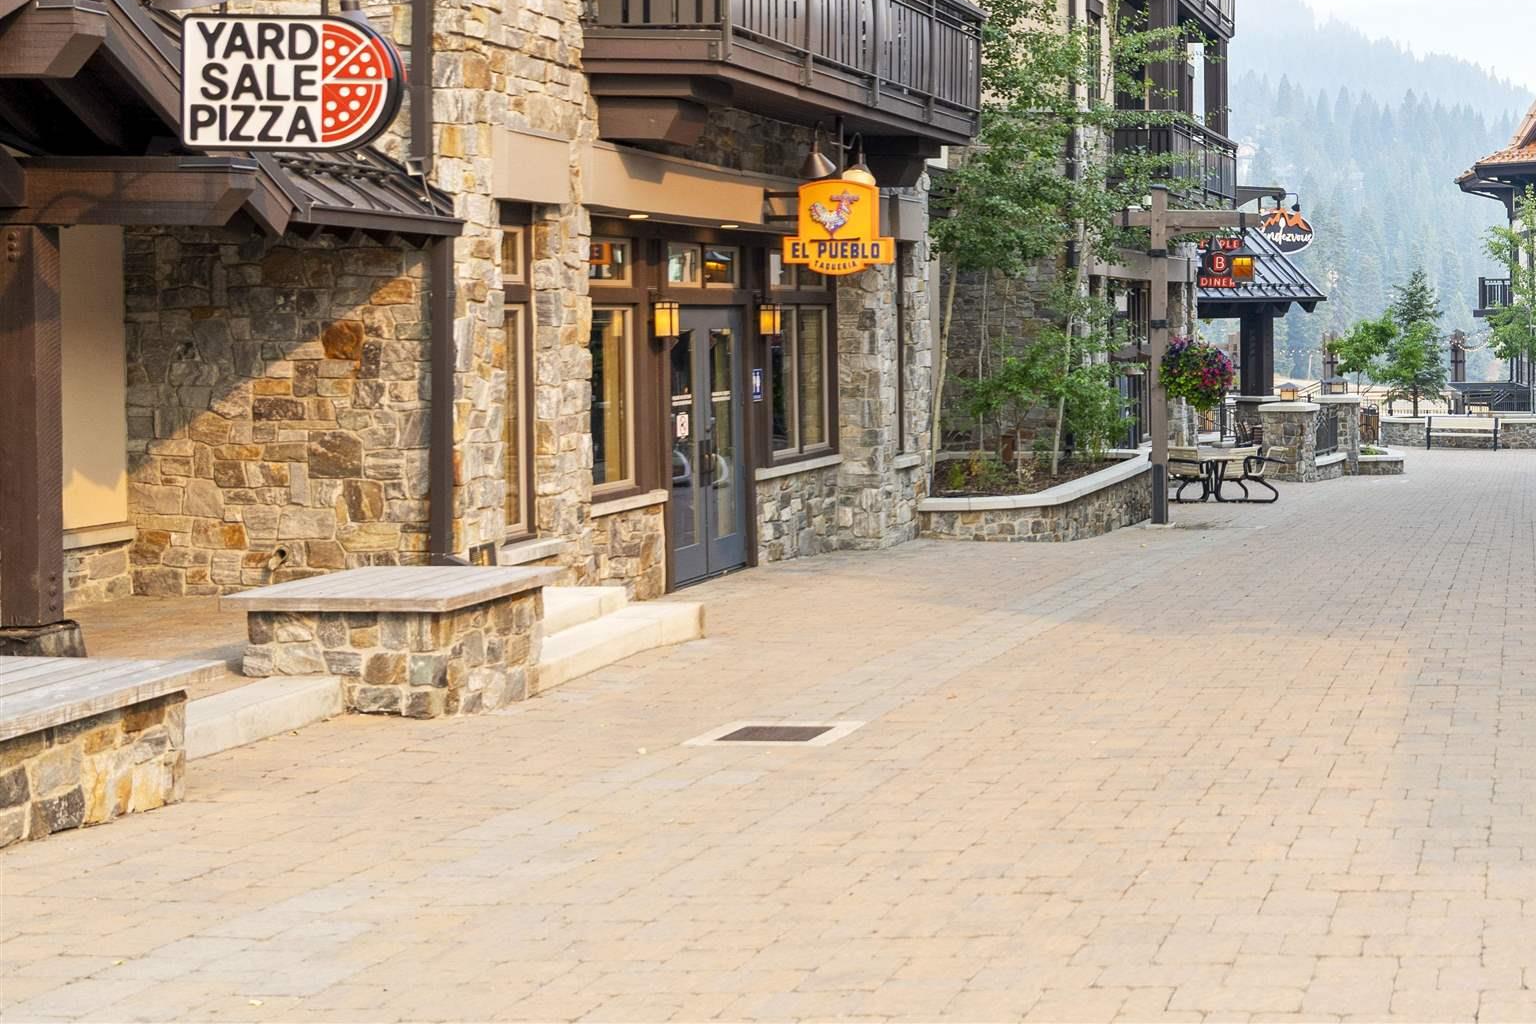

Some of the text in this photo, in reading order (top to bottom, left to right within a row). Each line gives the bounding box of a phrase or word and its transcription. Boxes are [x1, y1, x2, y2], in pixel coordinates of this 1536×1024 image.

[196, 22, 319, 60] YARD
[200, 63, 318, 101] SALE
[190, 104, 317, 142] PIZZA
[792, 241, 880, 258] EL PUEBLO
[1215, 256, 1225, 269] B
[814, 260, 857, 270] TAQUERIA
